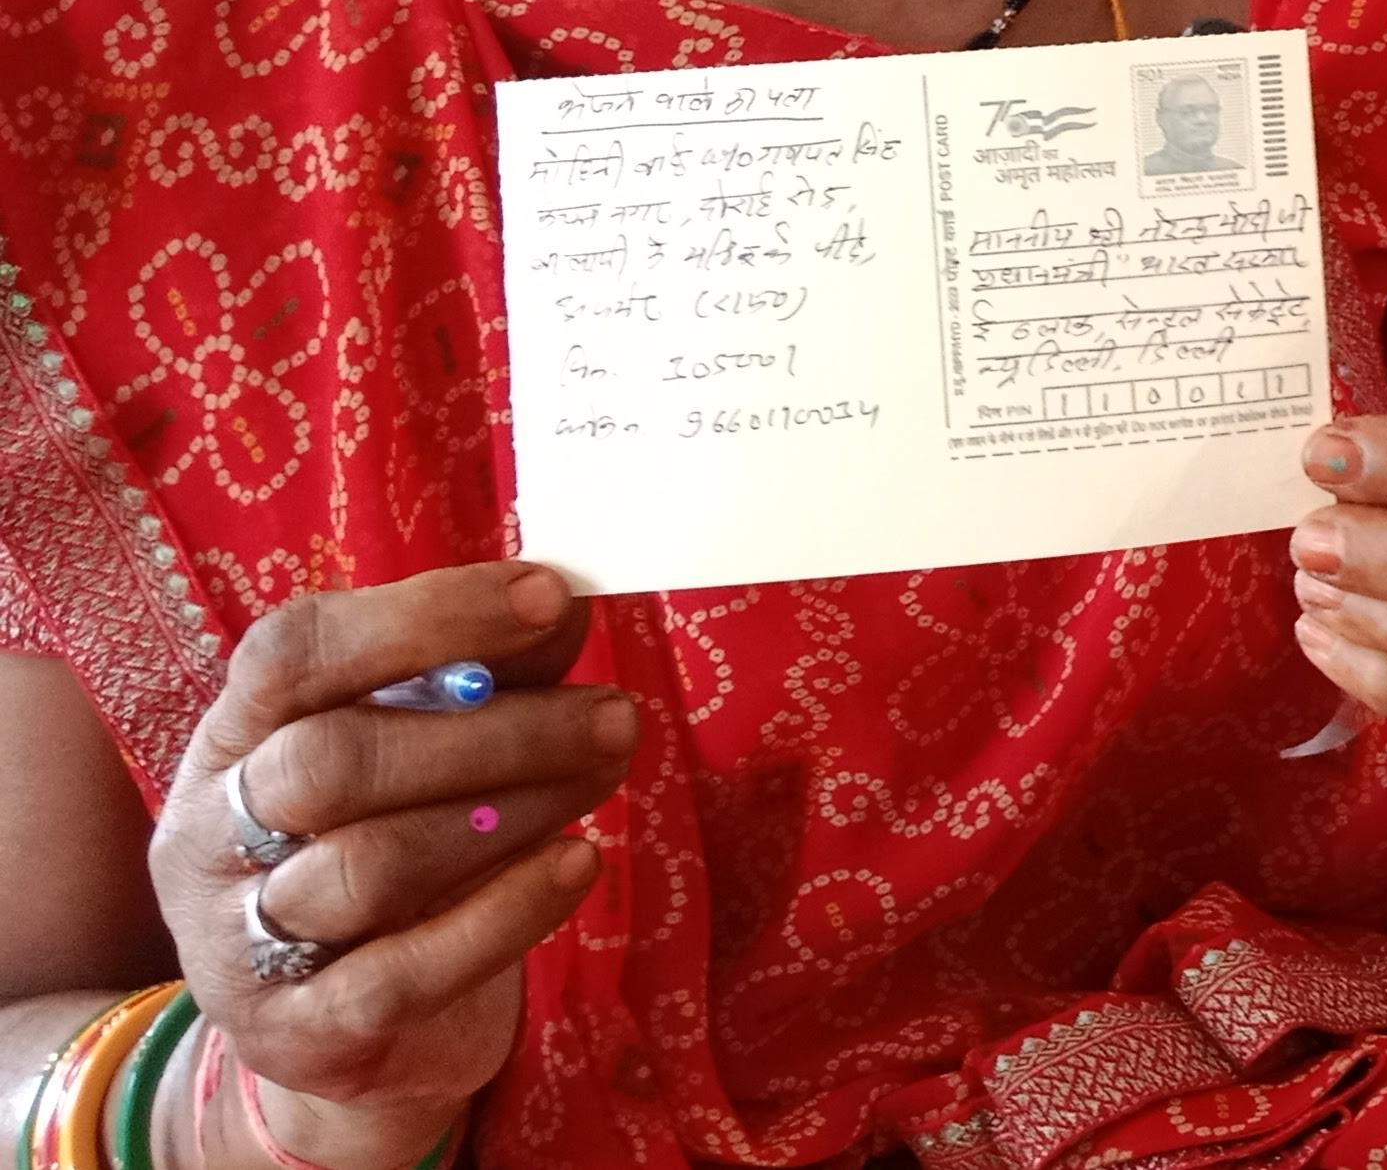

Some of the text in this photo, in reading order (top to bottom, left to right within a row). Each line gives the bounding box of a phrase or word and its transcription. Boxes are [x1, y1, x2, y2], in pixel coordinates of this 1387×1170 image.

[935, 114, 953, 201] POST CARD
[995, 157, 1118, 189] अमृत महोत्सव
